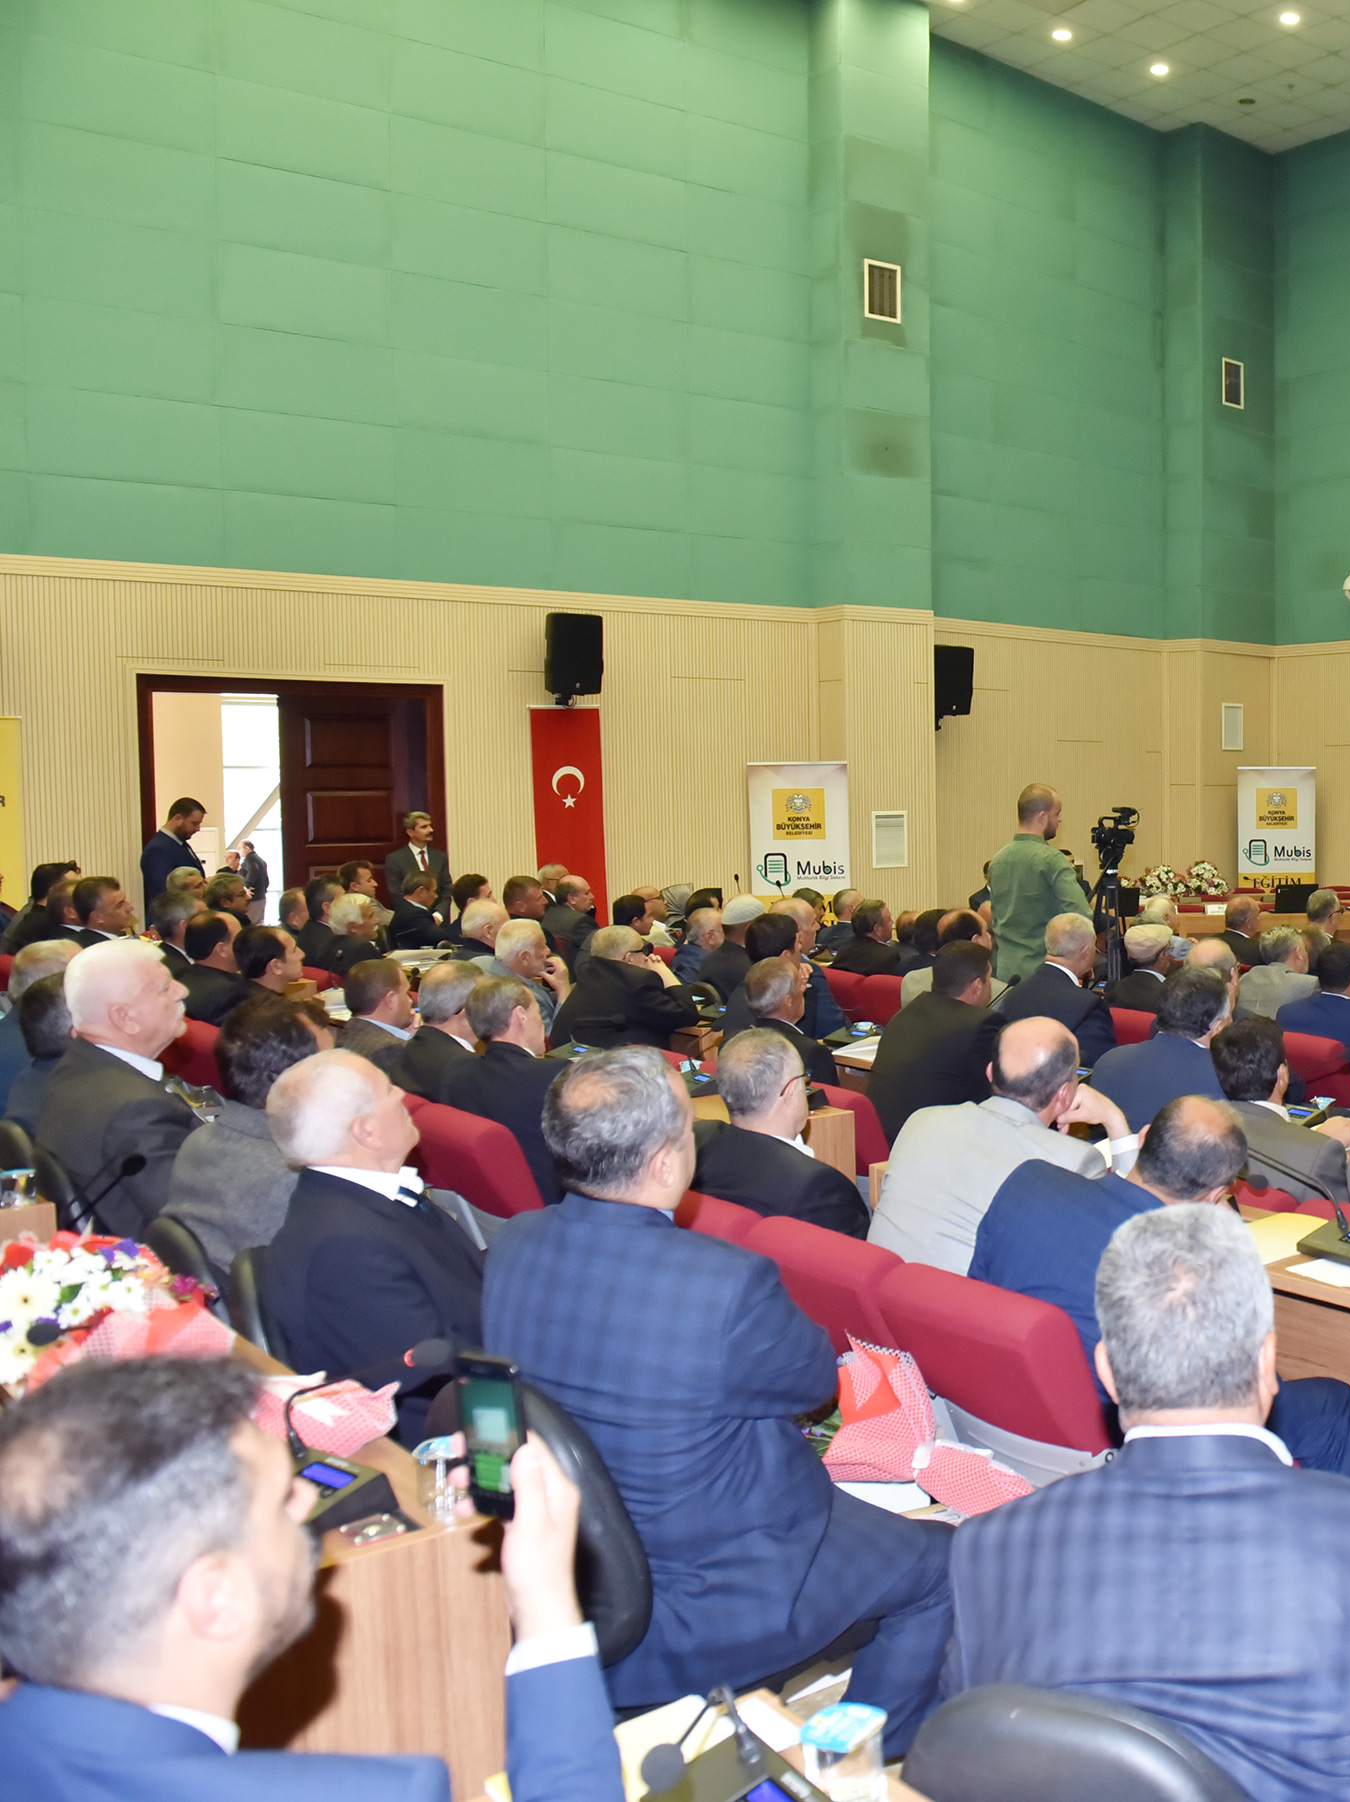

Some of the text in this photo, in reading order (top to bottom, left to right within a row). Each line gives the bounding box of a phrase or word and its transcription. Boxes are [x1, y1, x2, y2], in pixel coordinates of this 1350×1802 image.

[776, 822, 822, 831] BÜYÜKŞEHİR
[1274, 845, 1312, 857] Mubis
[797, 860, 845, 875] Mubis
